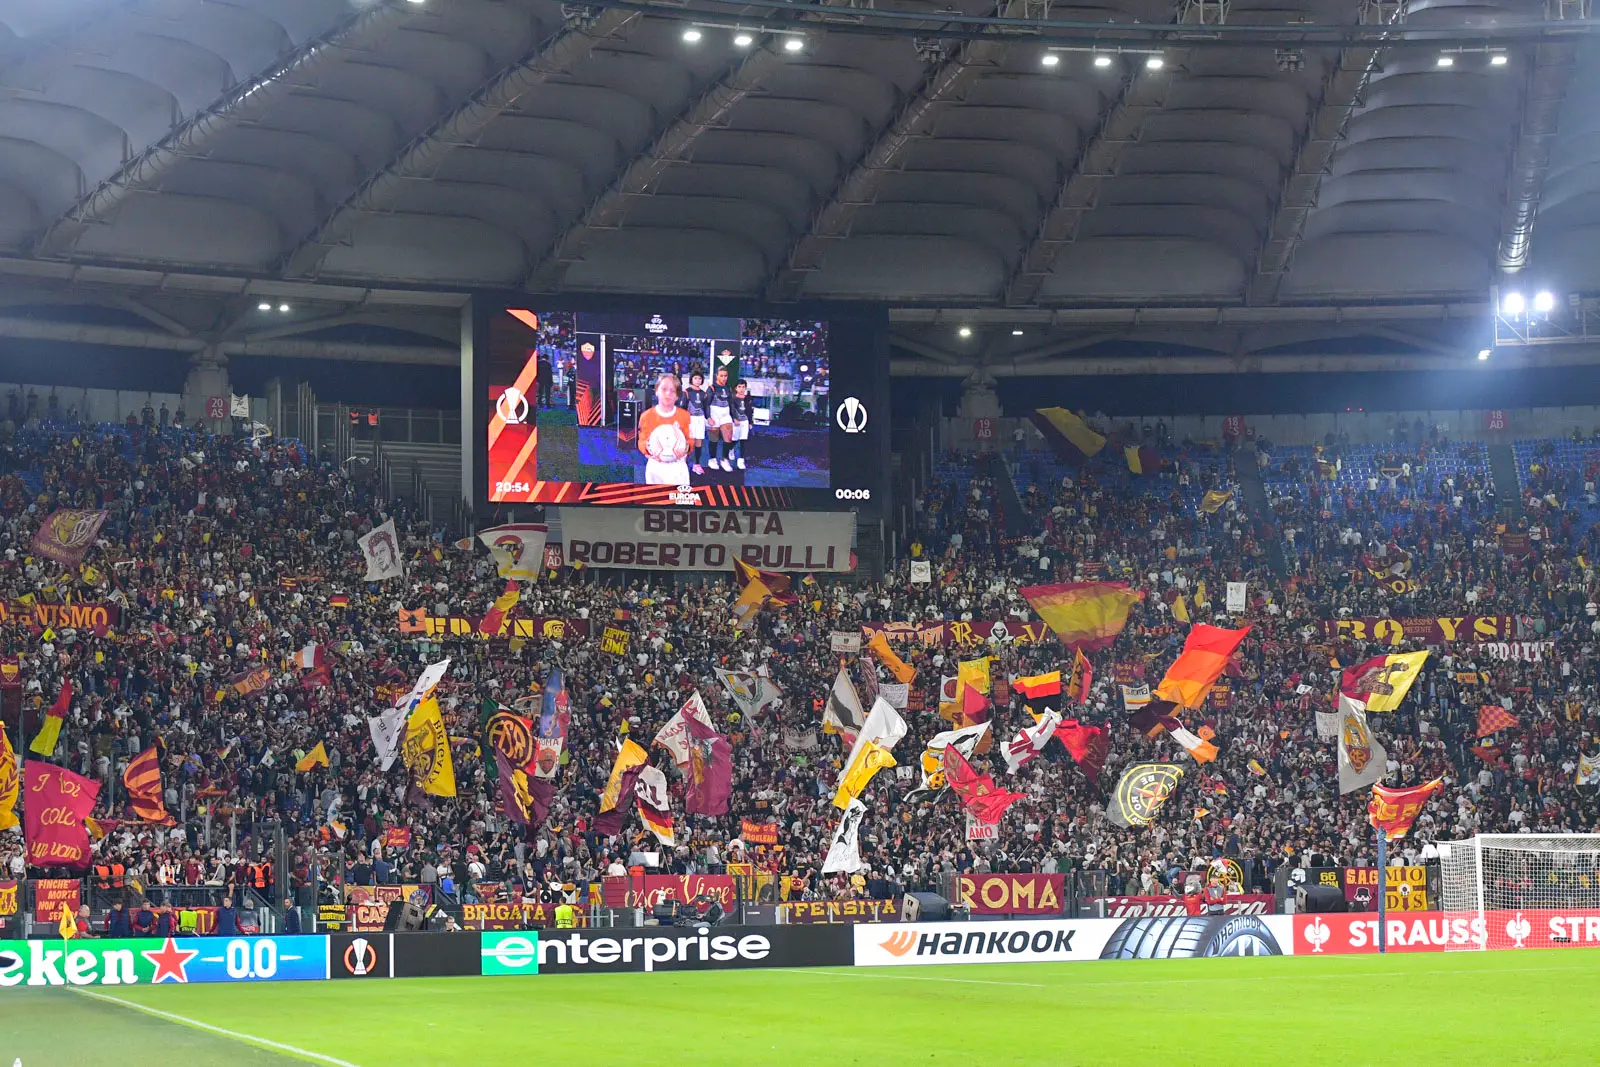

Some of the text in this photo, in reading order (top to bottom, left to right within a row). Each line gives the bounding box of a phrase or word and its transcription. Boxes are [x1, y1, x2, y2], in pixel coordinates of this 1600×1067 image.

[212, 398, 223, 408] 20
[211, 408, 223, 418] AS
[979, 419, 990, 429] 19
[1490, 420, 1504, 429] AD
[496, 482, 530, 493] 20:54
[669, 493, 701, 501] EUROPA
[835, 489, 870, 500] 00:06
[643, 510, 784, 536] BRIGATA
[569, 540, 836, 570] ROBERTO RULLI
[547, 556, 562, 568] AD
[969, 826, 993, 838] AMO
[48, 890, 77, 899] MORTE
[955, 877, 1060, 909] ROMA
[38, 901, 55, 910] NON
[463, 903, 547, 921] BRIGATA
[1349, 918, 1489, 947] STRAUSS
[484, 927, 771, 972] enterprise
